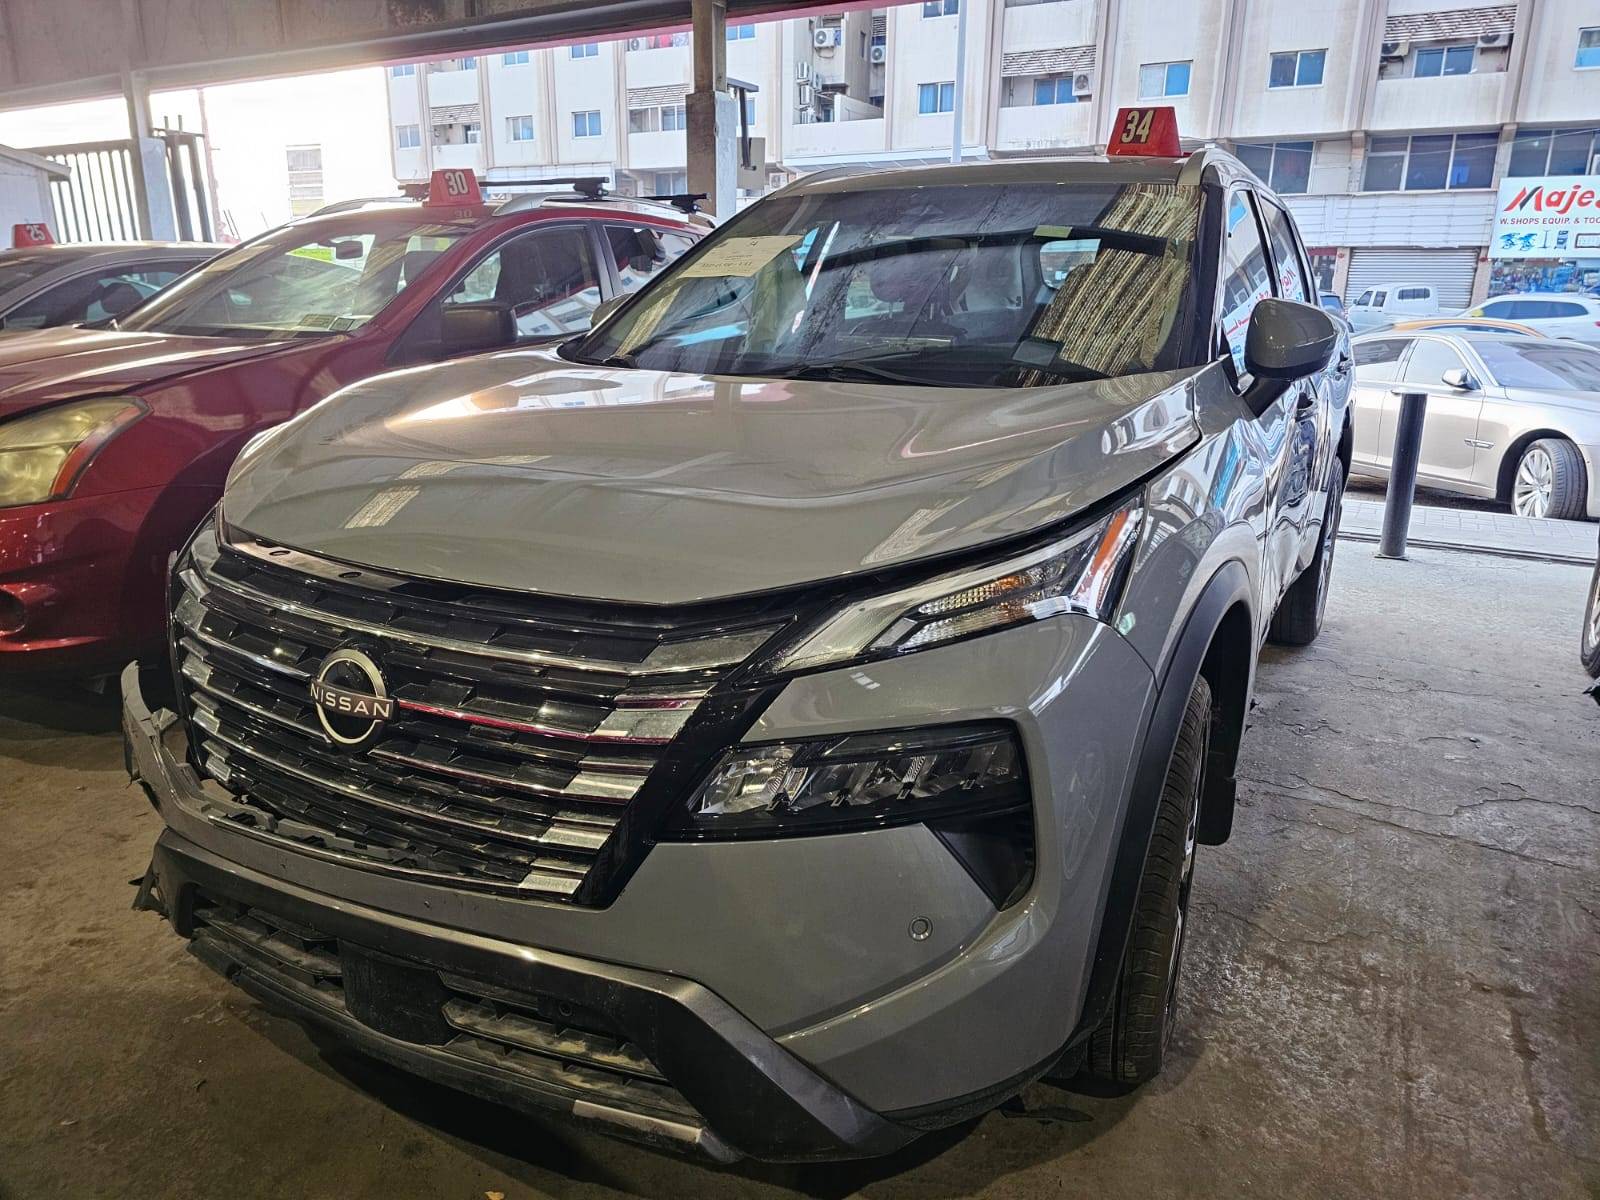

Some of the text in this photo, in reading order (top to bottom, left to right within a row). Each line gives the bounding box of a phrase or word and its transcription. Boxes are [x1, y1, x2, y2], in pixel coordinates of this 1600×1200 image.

[1121, 110, 1155, 143] 34
[444, 171, 469, 196] 30
[1503, 184, 1600, 214] Maje
[26, 224, 46, 241] 25
[1510, 217, 1540, 225] SHOPS
[1574, 217, 1581, 225] &
[310, 682, 390, 718] NISSAN
